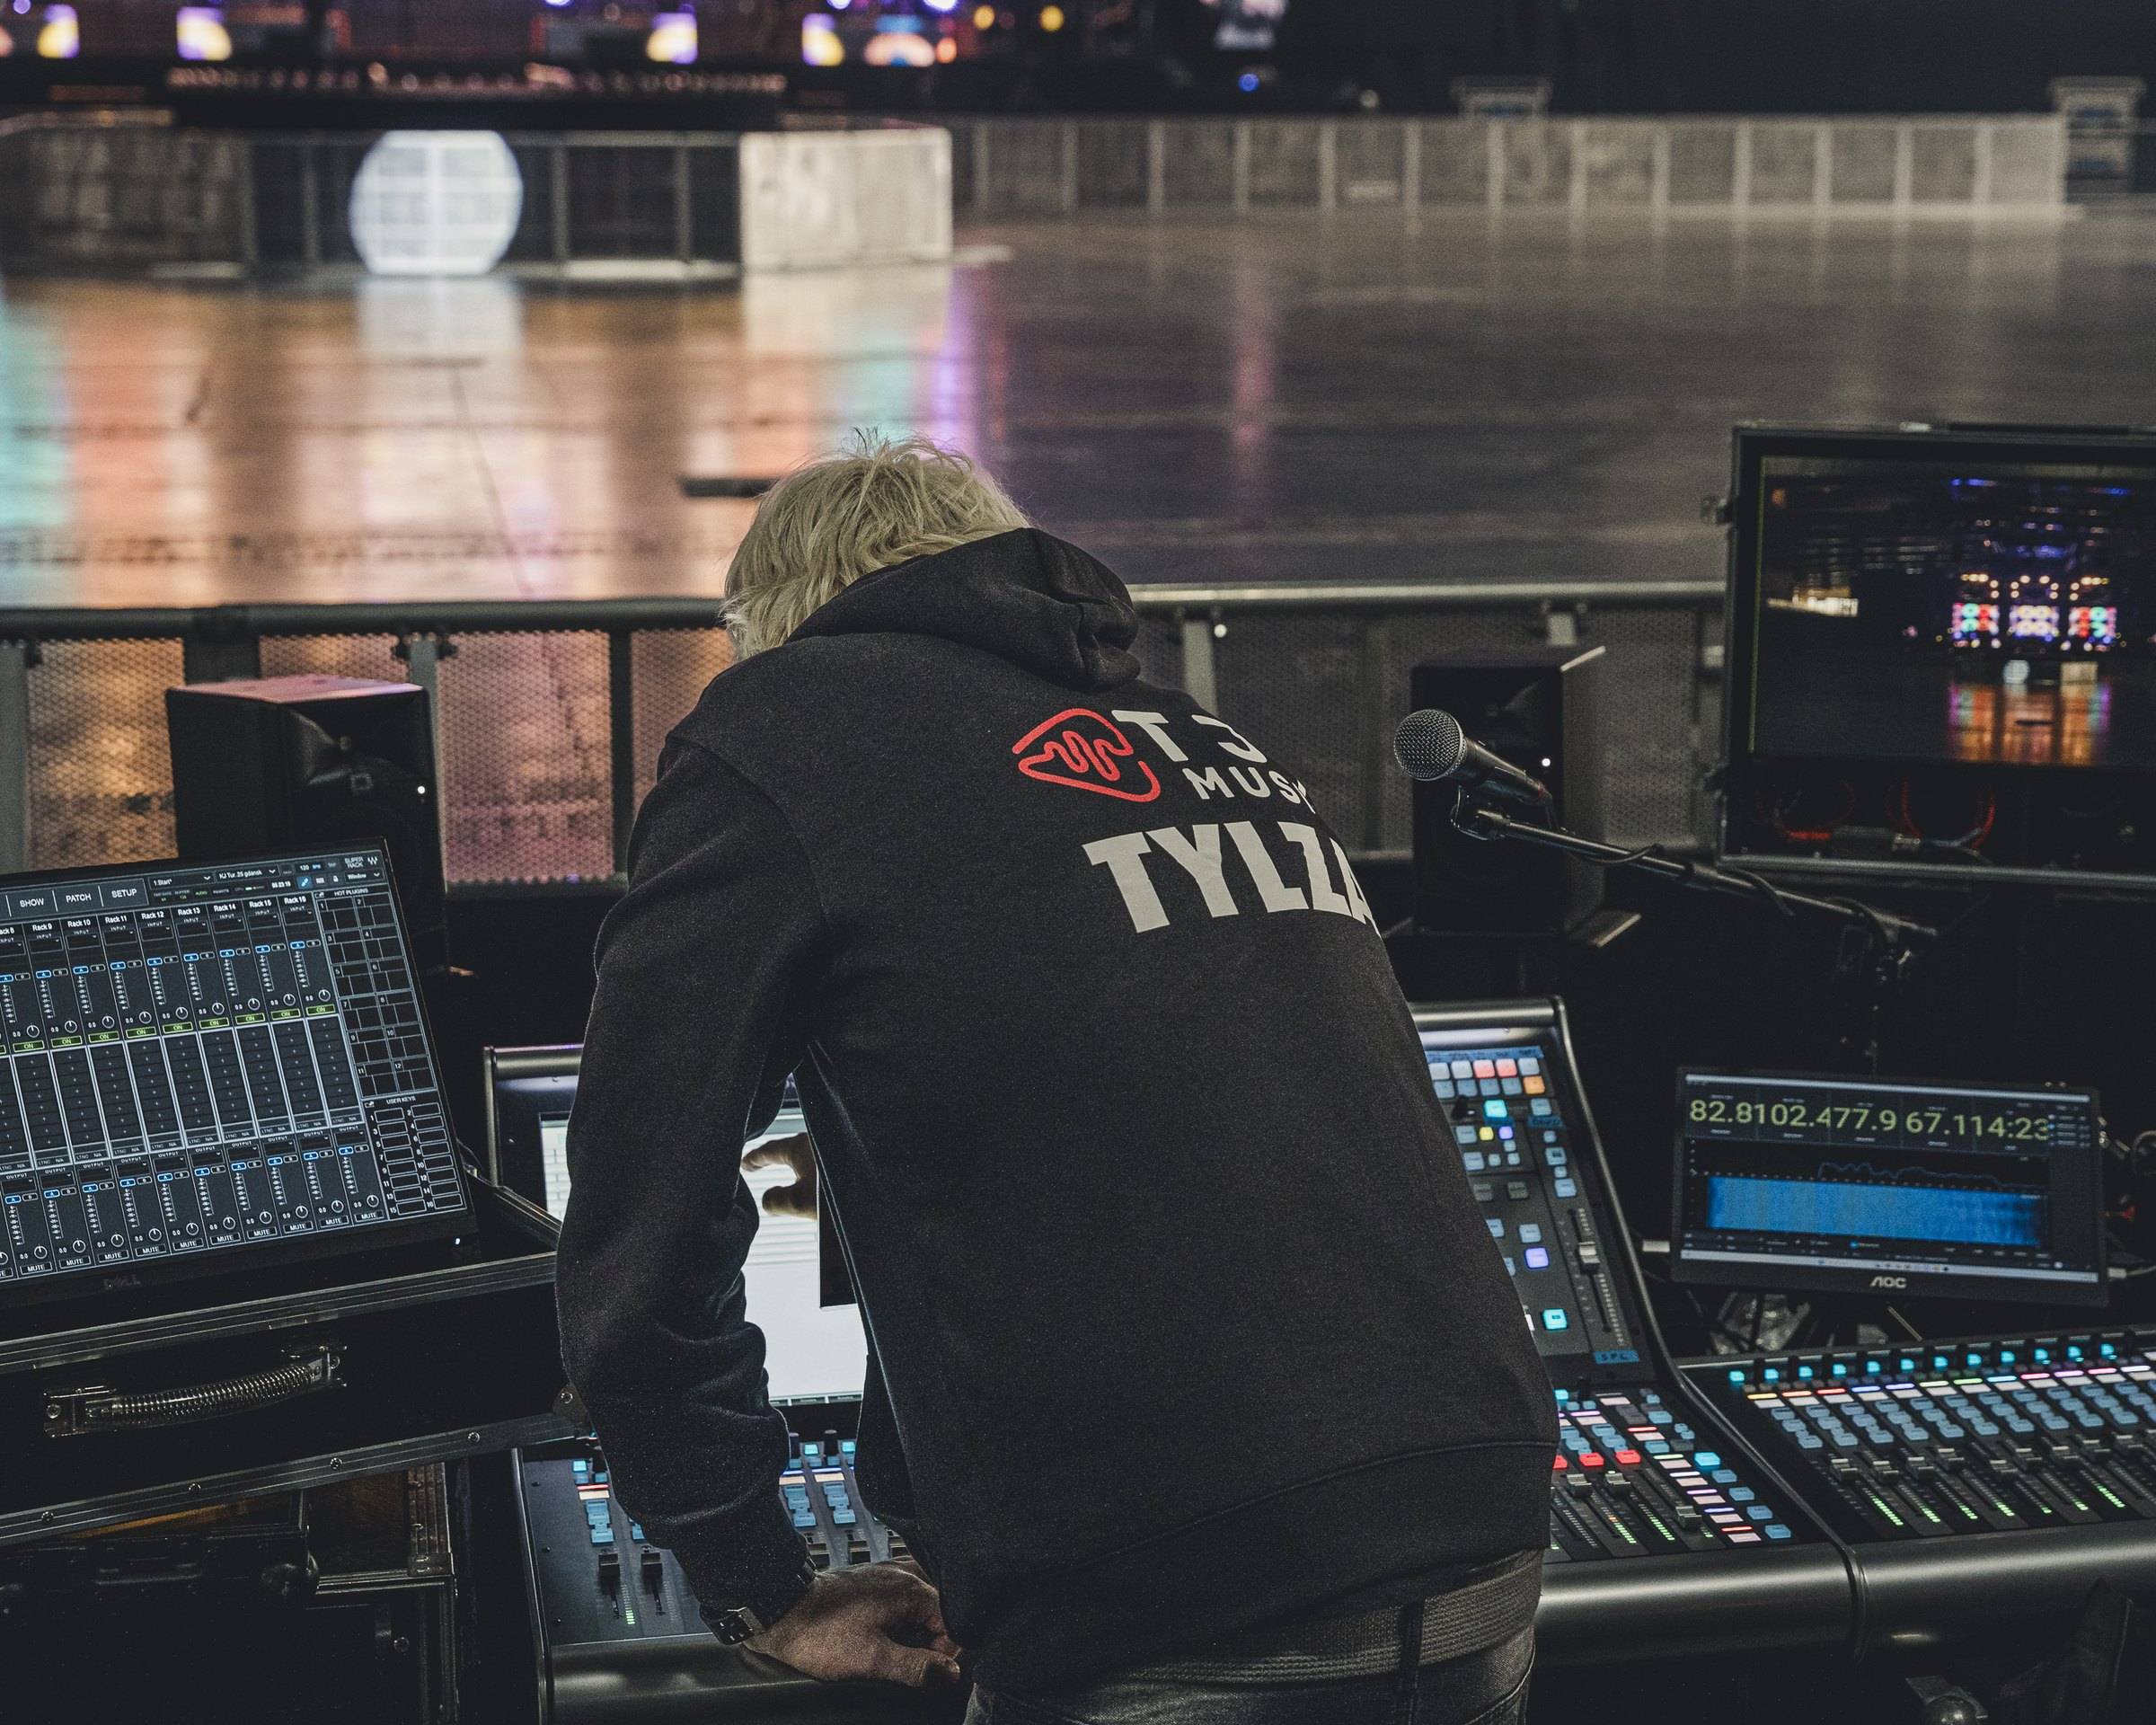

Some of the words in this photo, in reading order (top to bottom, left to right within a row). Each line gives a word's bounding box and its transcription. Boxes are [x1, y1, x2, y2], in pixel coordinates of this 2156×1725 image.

[66, 893, 92, 903] PATCH
[111, 889, 137, 898] SETUP
[20, 898, 44, 907] SHOW
[284, 897, 299, 905] Rack
[141, 912, 156, 920] Rack
[67, 920, 83, 928] Rack
[1870, 1276, 1906, 1288] AOC
